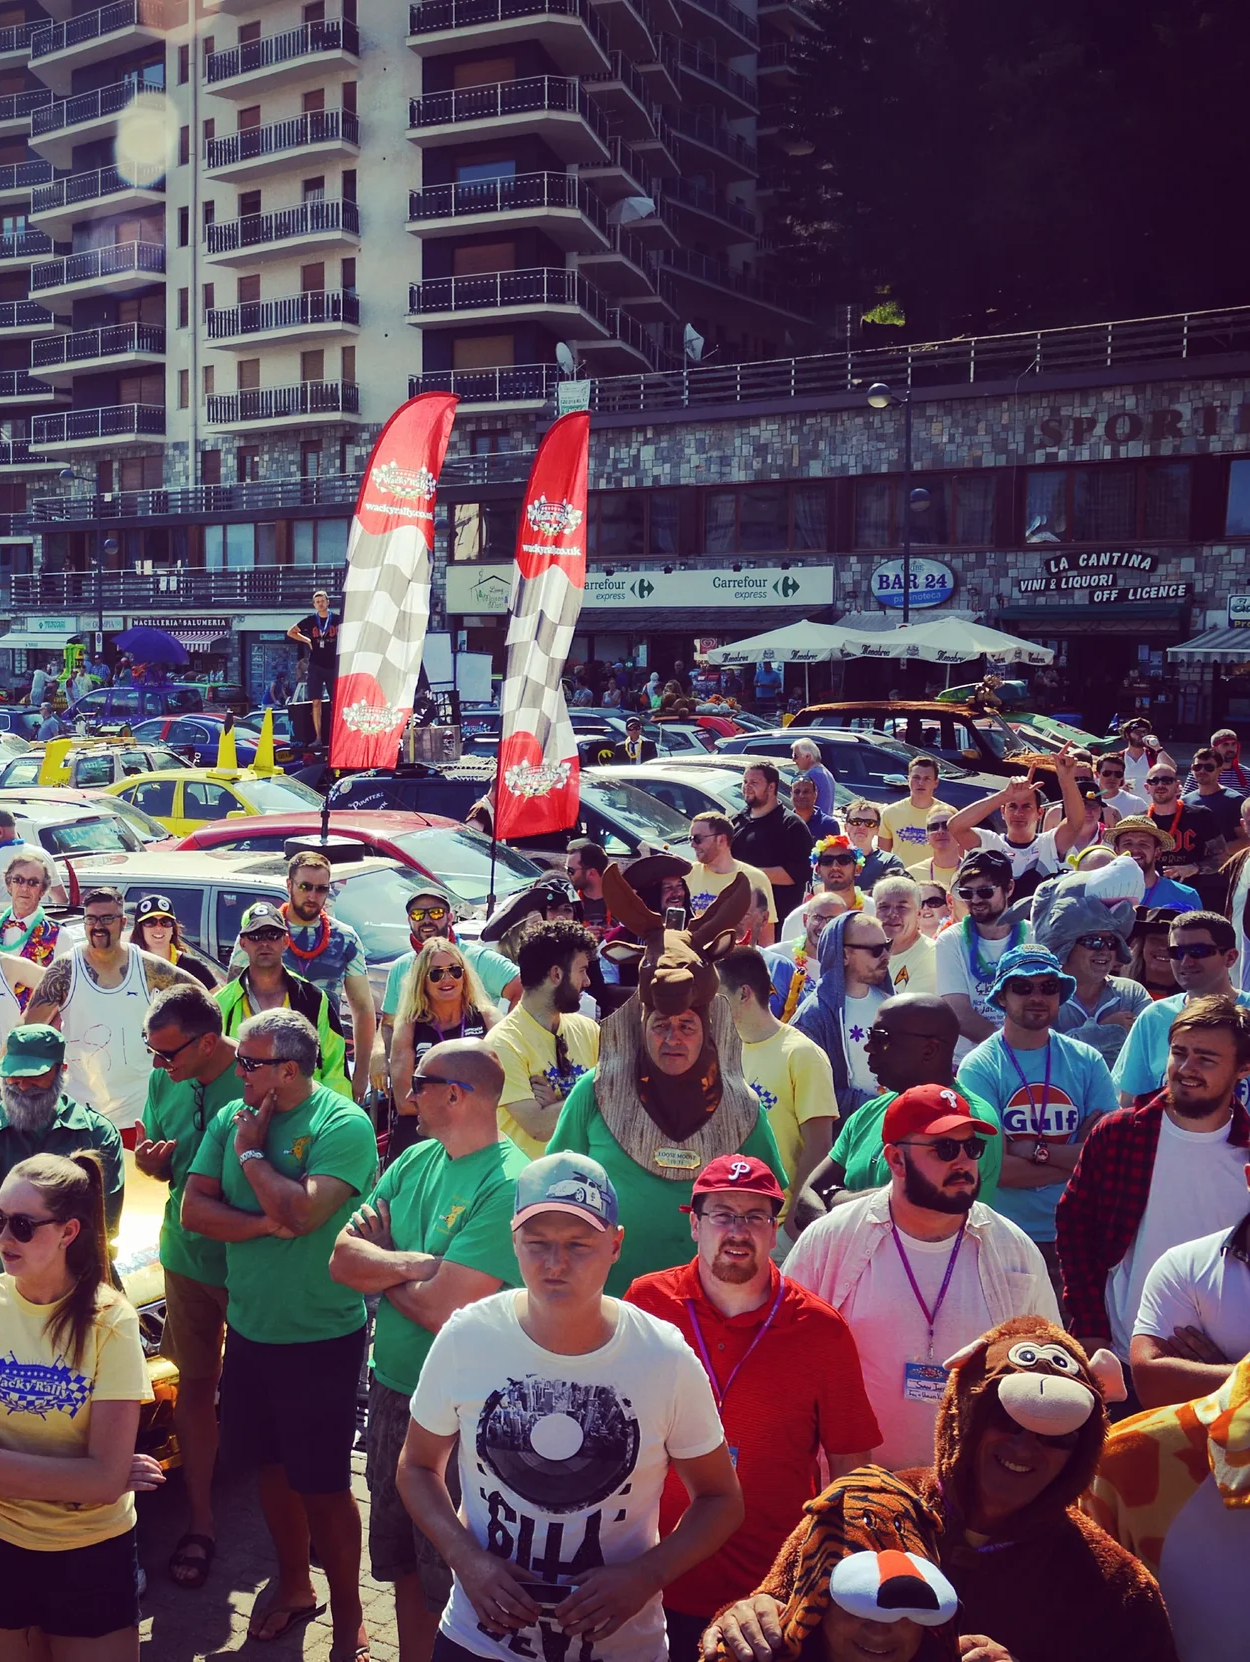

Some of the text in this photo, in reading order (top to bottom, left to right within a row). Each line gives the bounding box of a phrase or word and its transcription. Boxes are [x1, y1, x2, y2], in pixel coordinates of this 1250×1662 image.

[1050, 552, 1152, 573] LA CANTINA
[584, 578, 626, 590] arrefour
[712, 576, 768, 588] Carrefour
[877, 573, 947, 590] BAR 24
[1020, 574, 1113, 591] VINI & LIQUORI
[595, 592, 626, 601] express
[734, 590, 767, 600] express
[1093, 584, 1187, 602] OFF LICENCE
[92, 620, 115, 629] OLMPIA
[133, 618, 226, 627] MACELLERIA SALUMERIA
[1004, 1110, 1077, 1132] Gulf
[728, 1162, 750, 1180] P
[35, 1380, 70, 1400] Rally
